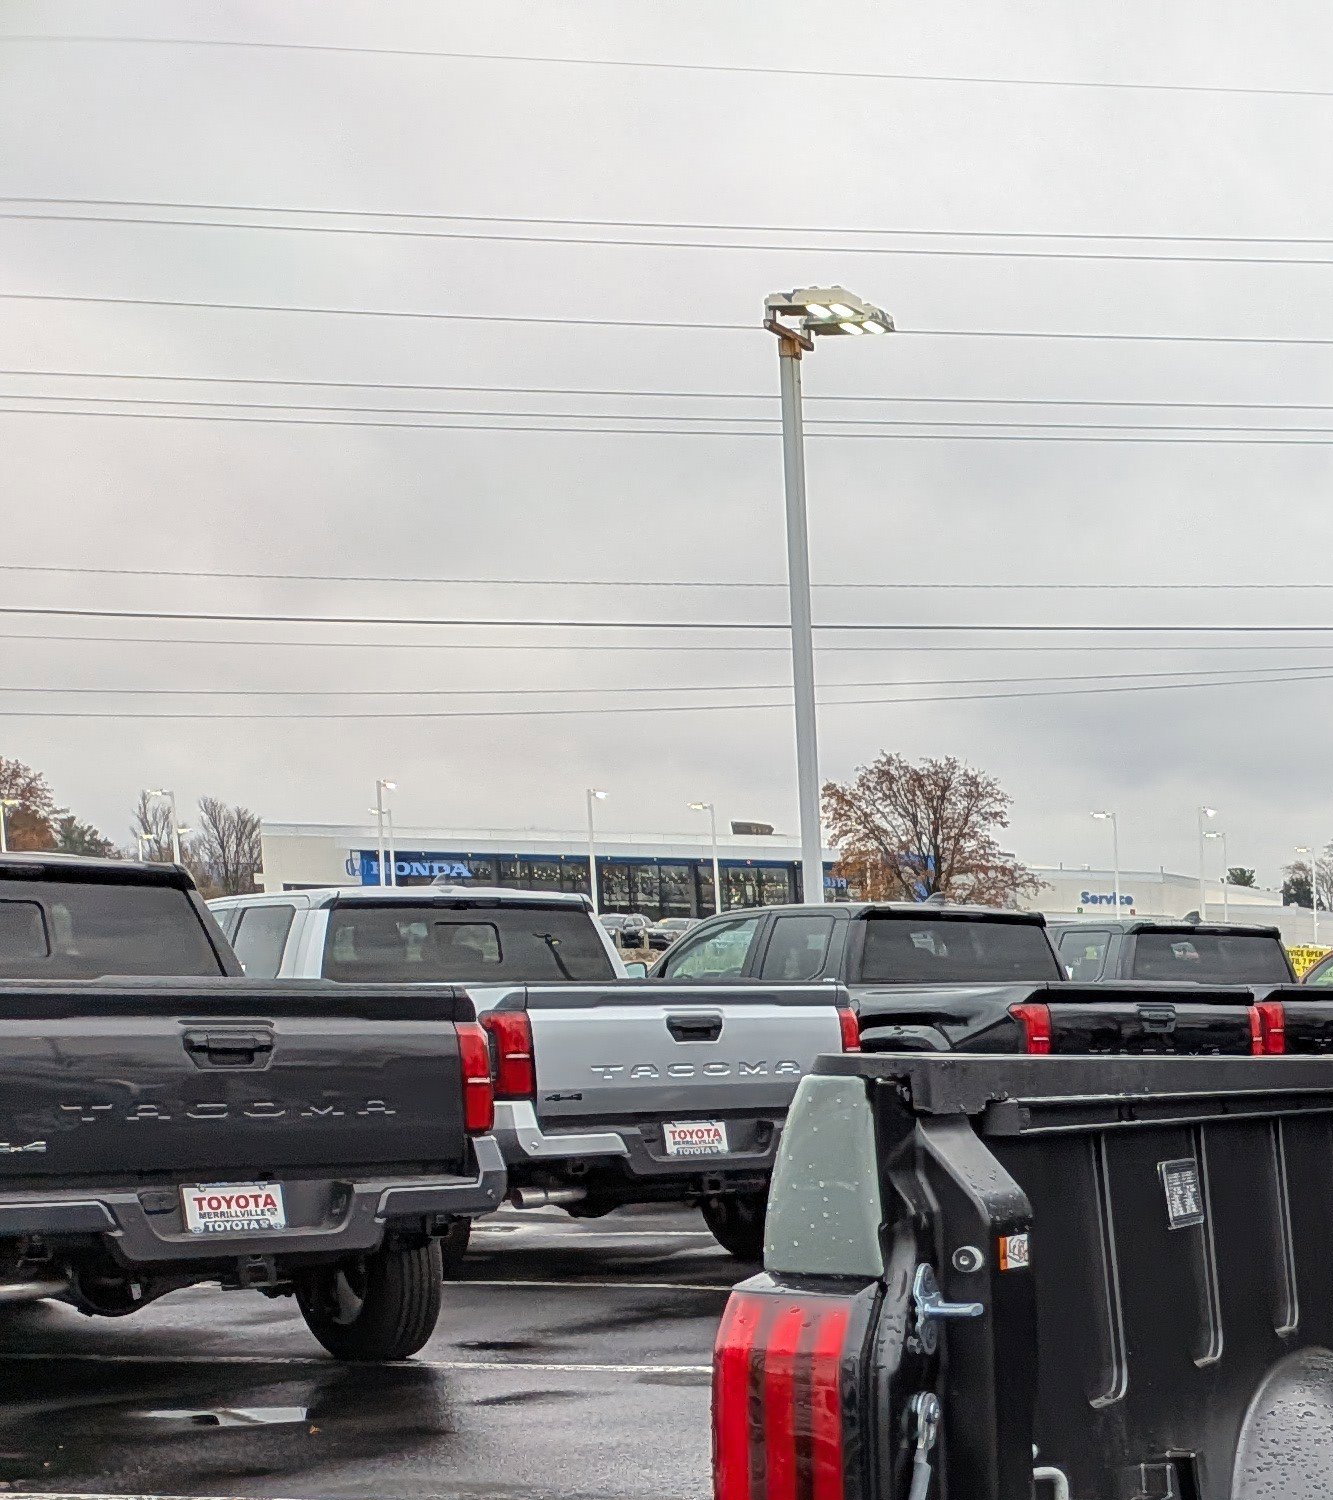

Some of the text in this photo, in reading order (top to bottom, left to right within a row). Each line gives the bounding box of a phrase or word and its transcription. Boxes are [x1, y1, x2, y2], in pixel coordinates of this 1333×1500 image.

[370, 861, 472, 877] HONDA
[1081, 892, 1134, 905] Service
[590, 1060, 801, 1079] TACOMA
[60, 1097, 397, 1121] TACOMA
[669, 1128, 722, 1141] TOYOTA
[678, 1147, 712, 1156] TOYOTA
[193, 1193, 278, 1212] TOYOTA
[199, 1208, 267, 1220] MERRILLVILLE
[206, 1220, 259, 1232] TOYOTA
